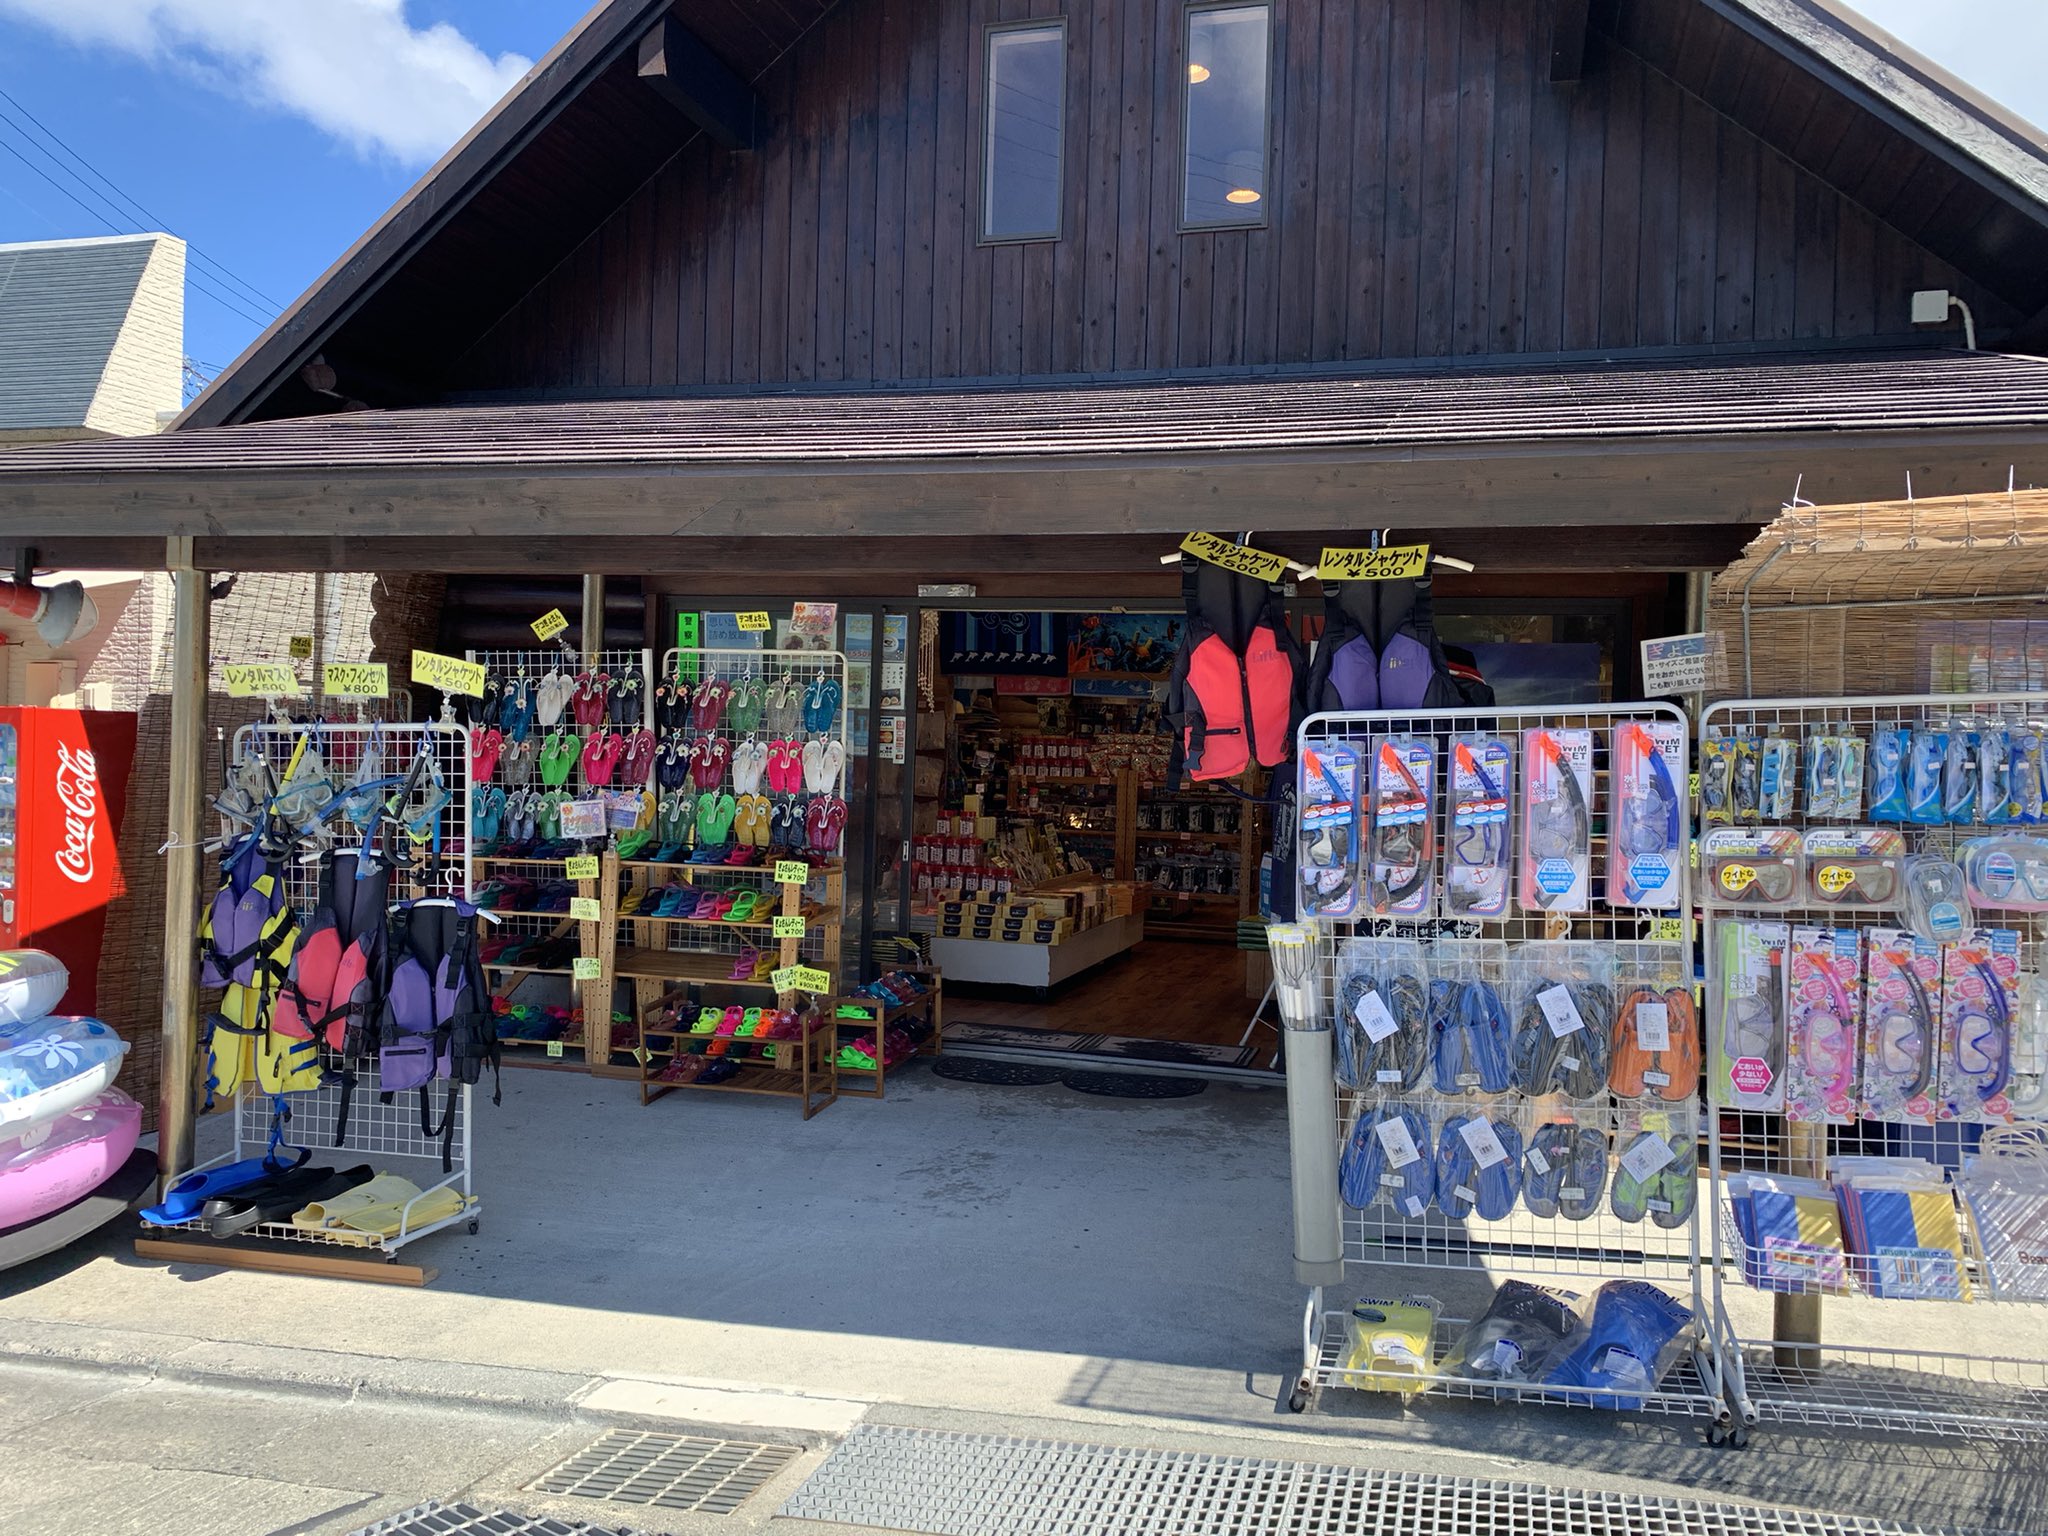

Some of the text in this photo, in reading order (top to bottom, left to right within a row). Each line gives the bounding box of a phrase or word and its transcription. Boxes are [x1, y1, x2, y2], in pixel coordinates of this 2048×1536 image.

[1190, 532, 1281, 571] レンタルジャケット
[1324, 547, 1423, 568] レンタルジャケット
[1207, 552, 1260, 575] ¥500
[1346, 567, 1405, 578] ¥500
[226, 667, 292, 684] レンタルマスク
[327, 667, 386, 684] マスク・フィンセット
[415, 653, 482, 684] レンタルジャケット
[250, 683, 287, 692] ¥500
[343, 684, 378, 694] ¥800
[1723, 869, 1755, 880] ワイドな
[1820, 871, 1853, 881] ワイドな
[1360, 1297, 1394, 1307] SWIM
